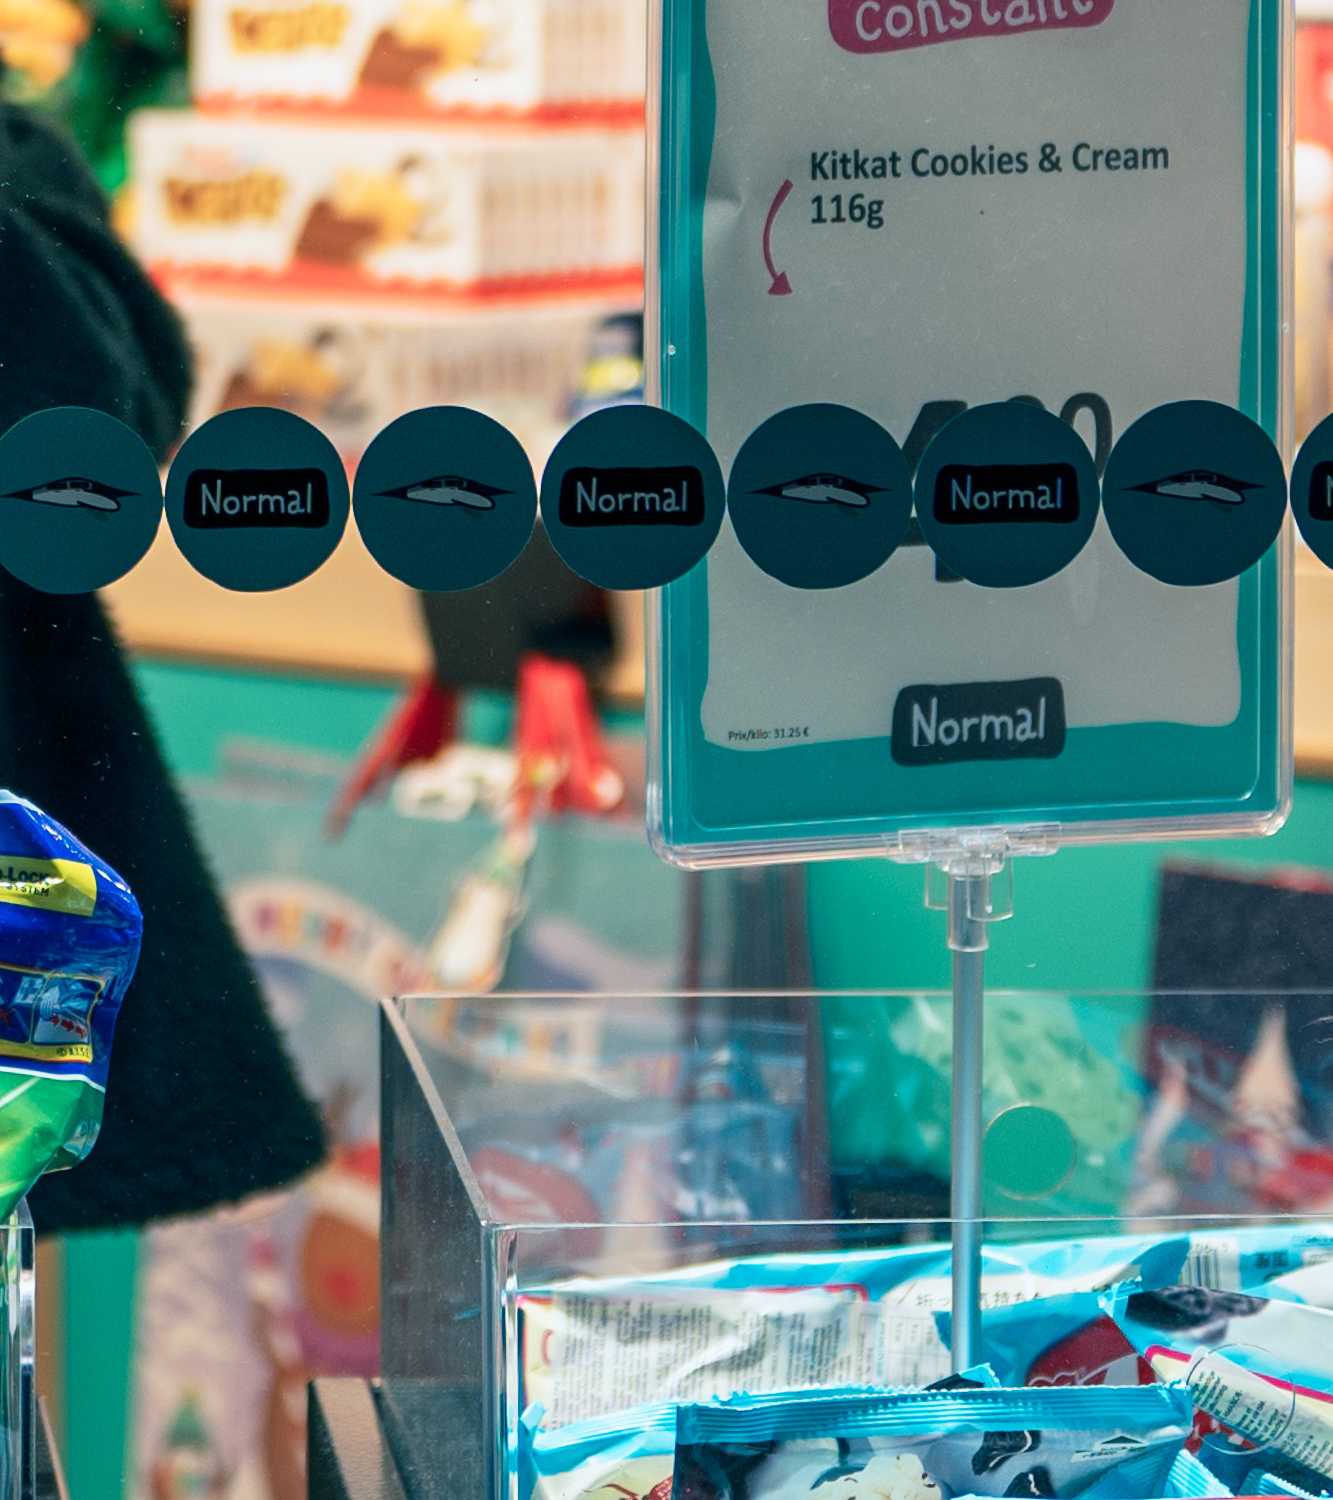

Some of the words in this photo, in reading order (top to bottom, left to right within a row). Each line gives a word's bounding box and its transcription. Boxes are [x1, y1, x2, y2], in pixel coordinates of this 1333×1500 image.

[810, 149, 902, 181] Kitkat
[911, 145, 1029, 178] Cookies
[1038, 142, 1063, 173] &
[1072, 143, 1170, 172] Cream
[811, 193, 884, 229] 116g
[201, 479, 312, 516] Normal
[576, 477, 687, 513] Normal
[951, 474, 1062, 511] Normal
[911, 694, 1046, 747] Normal
